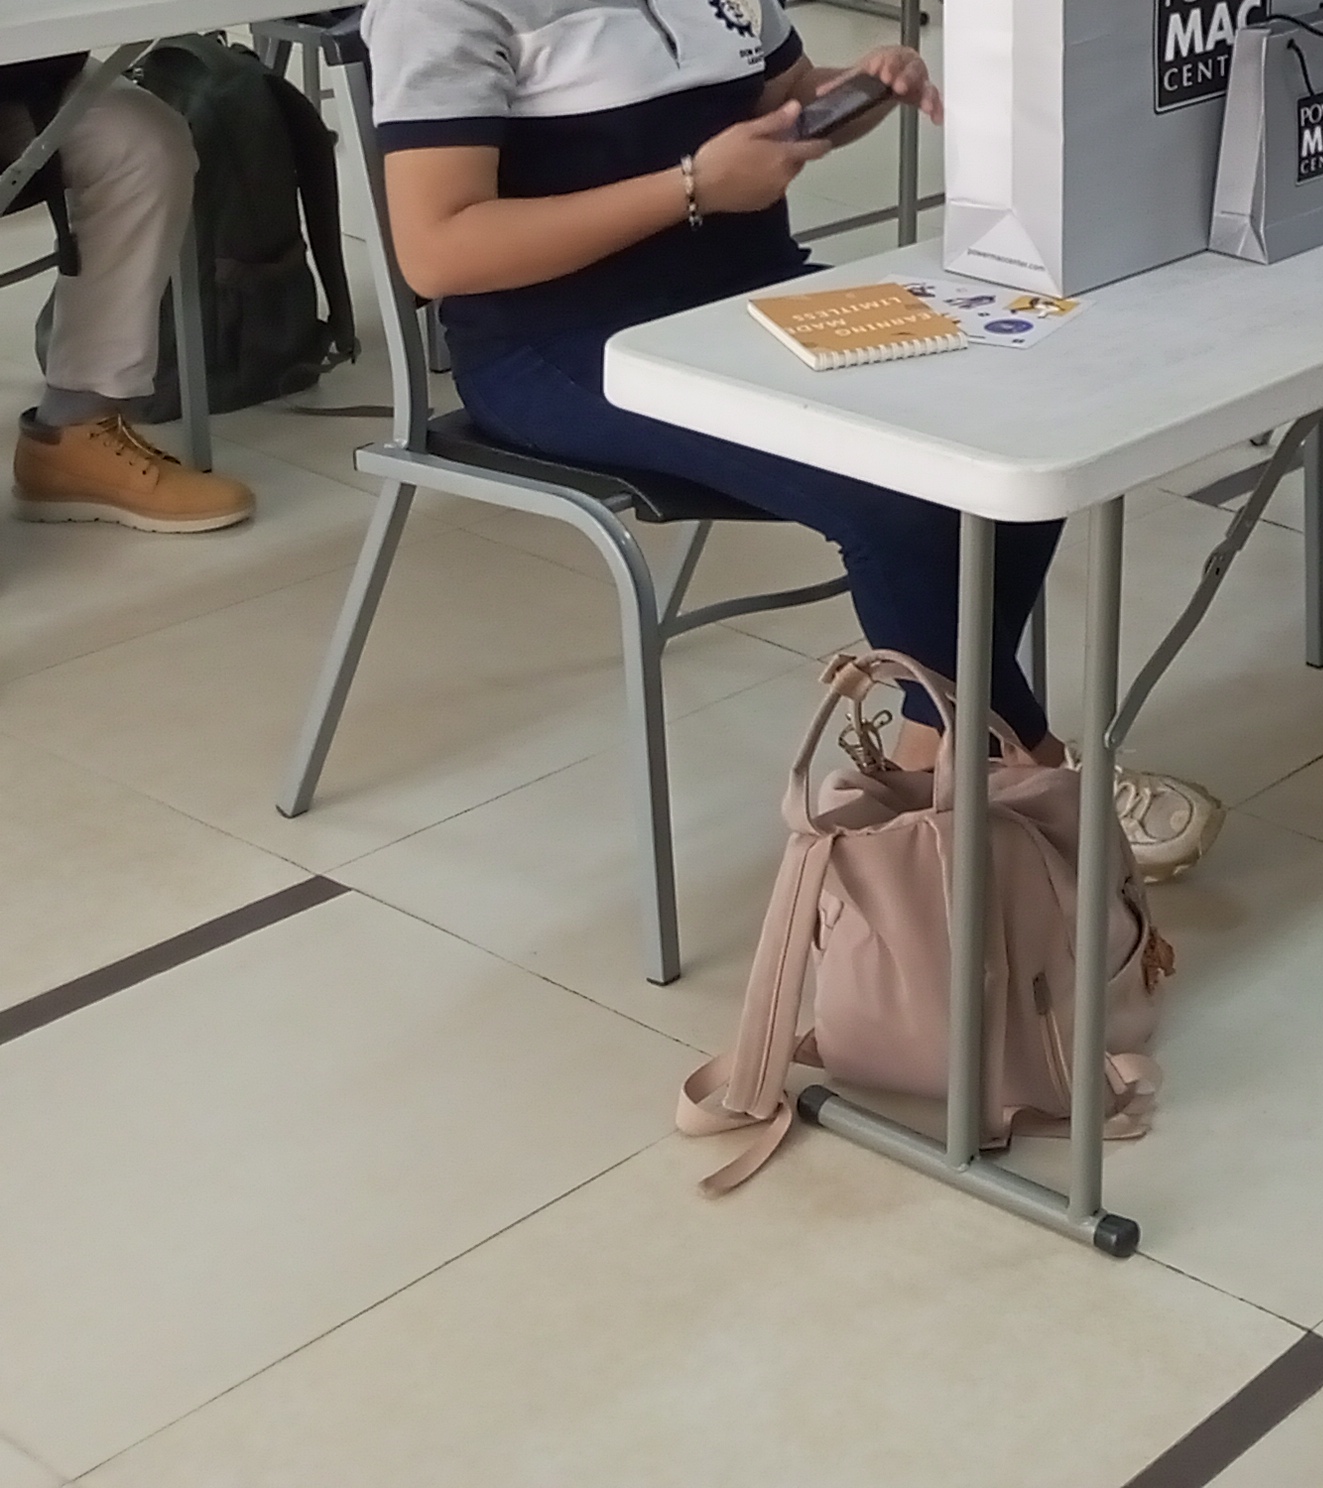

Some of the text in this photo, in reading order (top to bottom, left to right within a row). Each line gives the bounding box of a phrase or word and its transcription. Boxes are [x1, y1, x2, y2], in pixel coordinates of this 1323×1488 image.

[1164, 54, 1228, 92] CENT
[792, 297, 902, 322] LIMITLESS
[834, 312, 932, 337] EARNING
